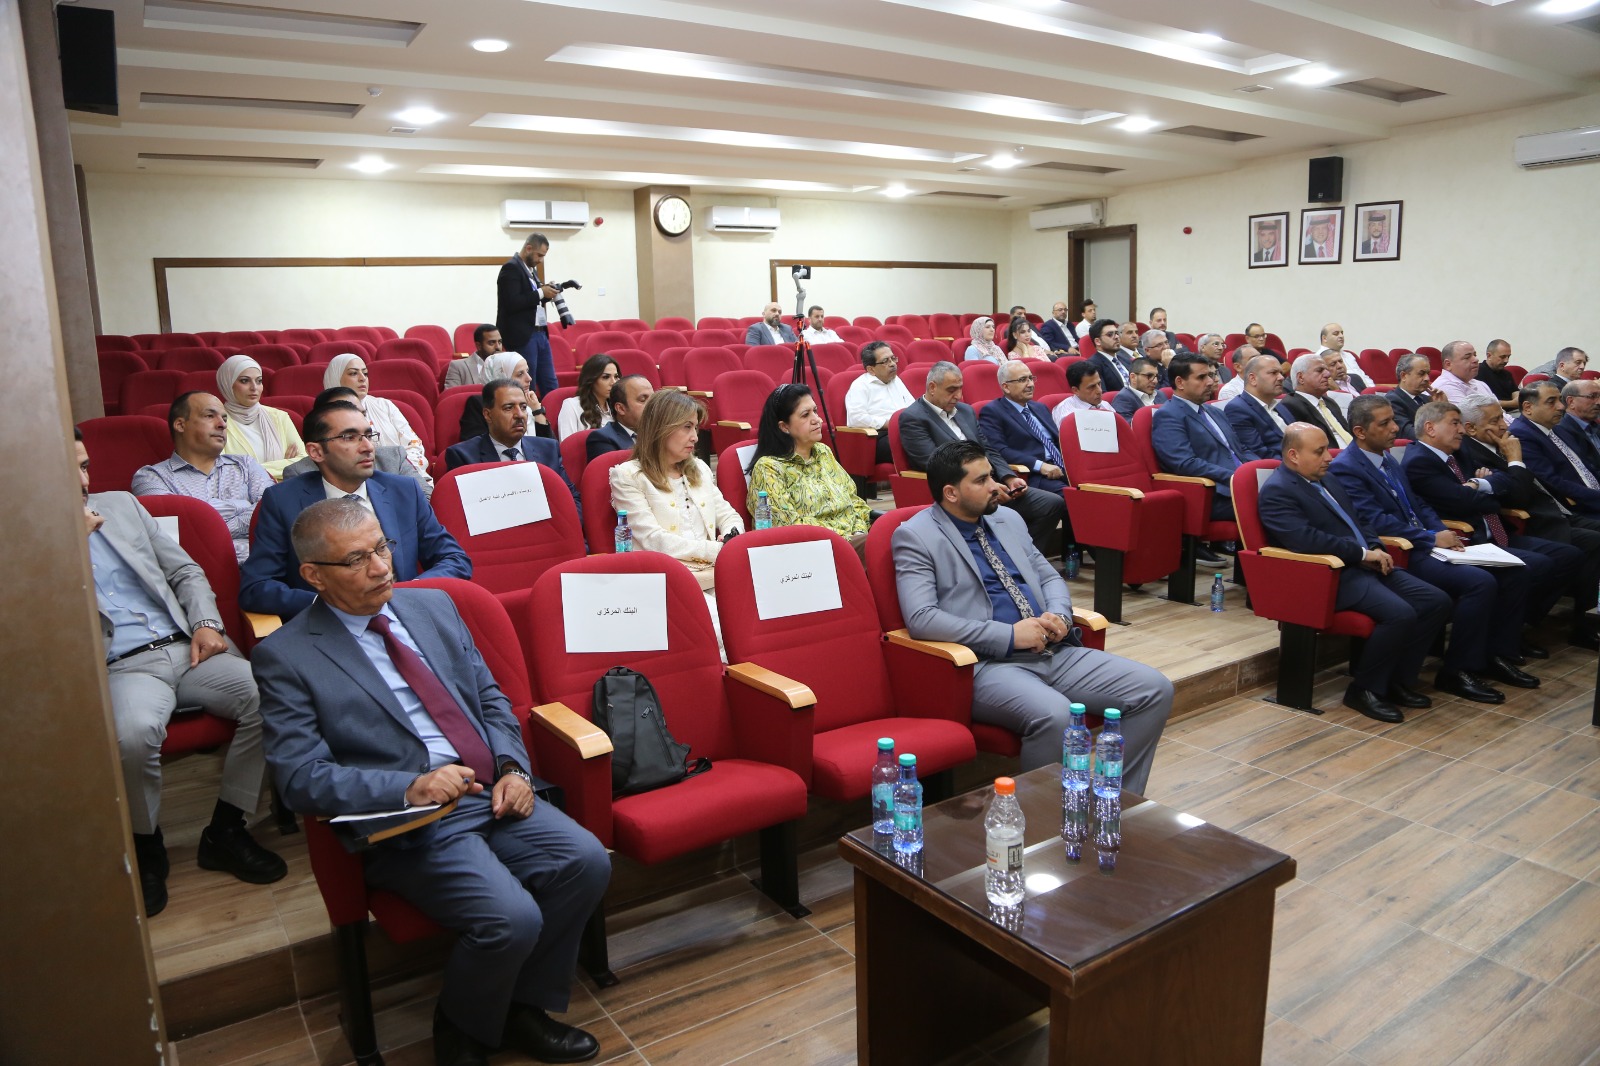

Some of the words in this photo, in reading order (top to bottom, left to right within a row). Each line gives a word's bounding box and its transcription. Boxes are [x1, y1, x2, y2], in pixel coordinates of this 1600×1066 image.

[779, 573, 800, 584] المركزي
[800, 571, 813, 580] البنك
[596, 607, 622, 616] المركزي
[623, 606, 638, 616] البنك
